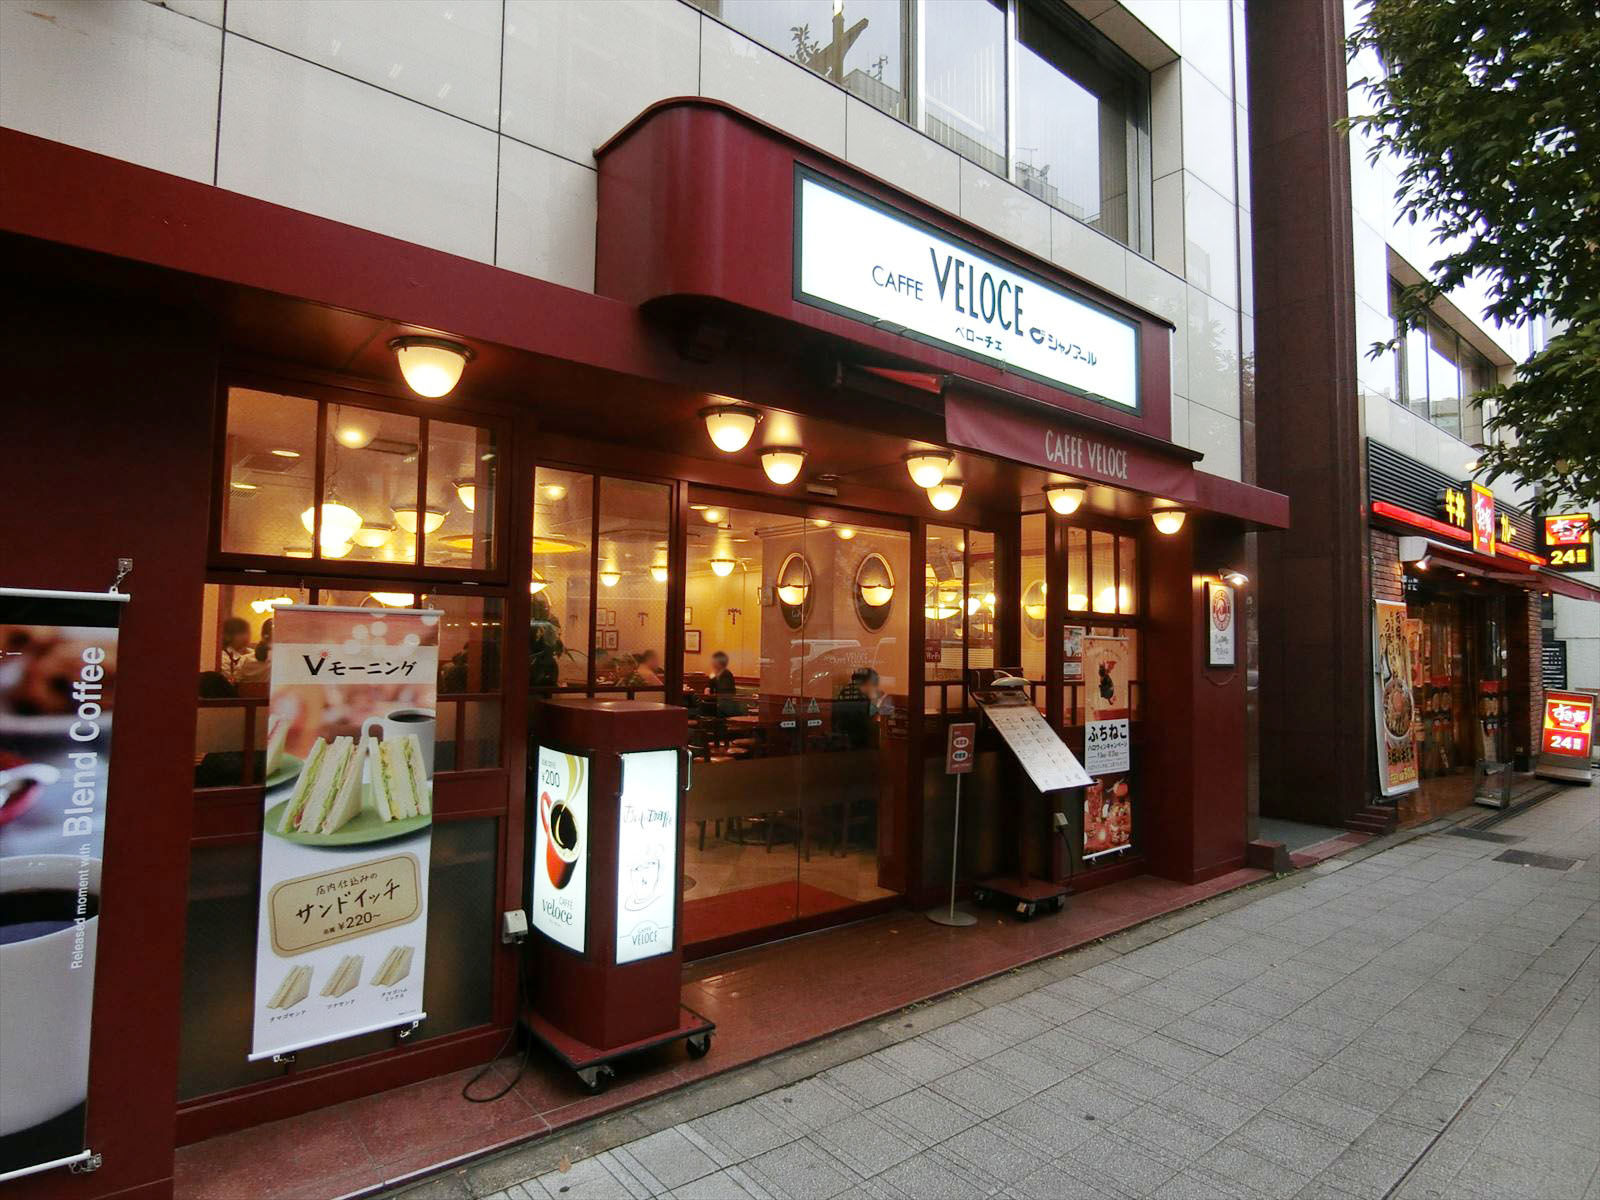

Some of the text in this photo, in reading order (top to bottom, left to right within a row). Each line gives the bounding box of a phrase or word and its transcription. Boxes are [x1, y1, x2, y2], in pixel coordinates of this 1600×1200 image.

[872, 247, 1024, 337] CAFFE VELOCE
[1087, 440, 1128, 479] VELOCE
[69, 647, 105, 743] Coffee
[1088, 724, 1127, 742] ふちねこ
[63, 752, 98, 837] Blend
[76, 868, 88, 915] moment
[296, 878, 400, 924] サンドイッチ
[316, 873, 378, 896] 店内仕込みの
[632, 930, 657, 945] VELOCE
